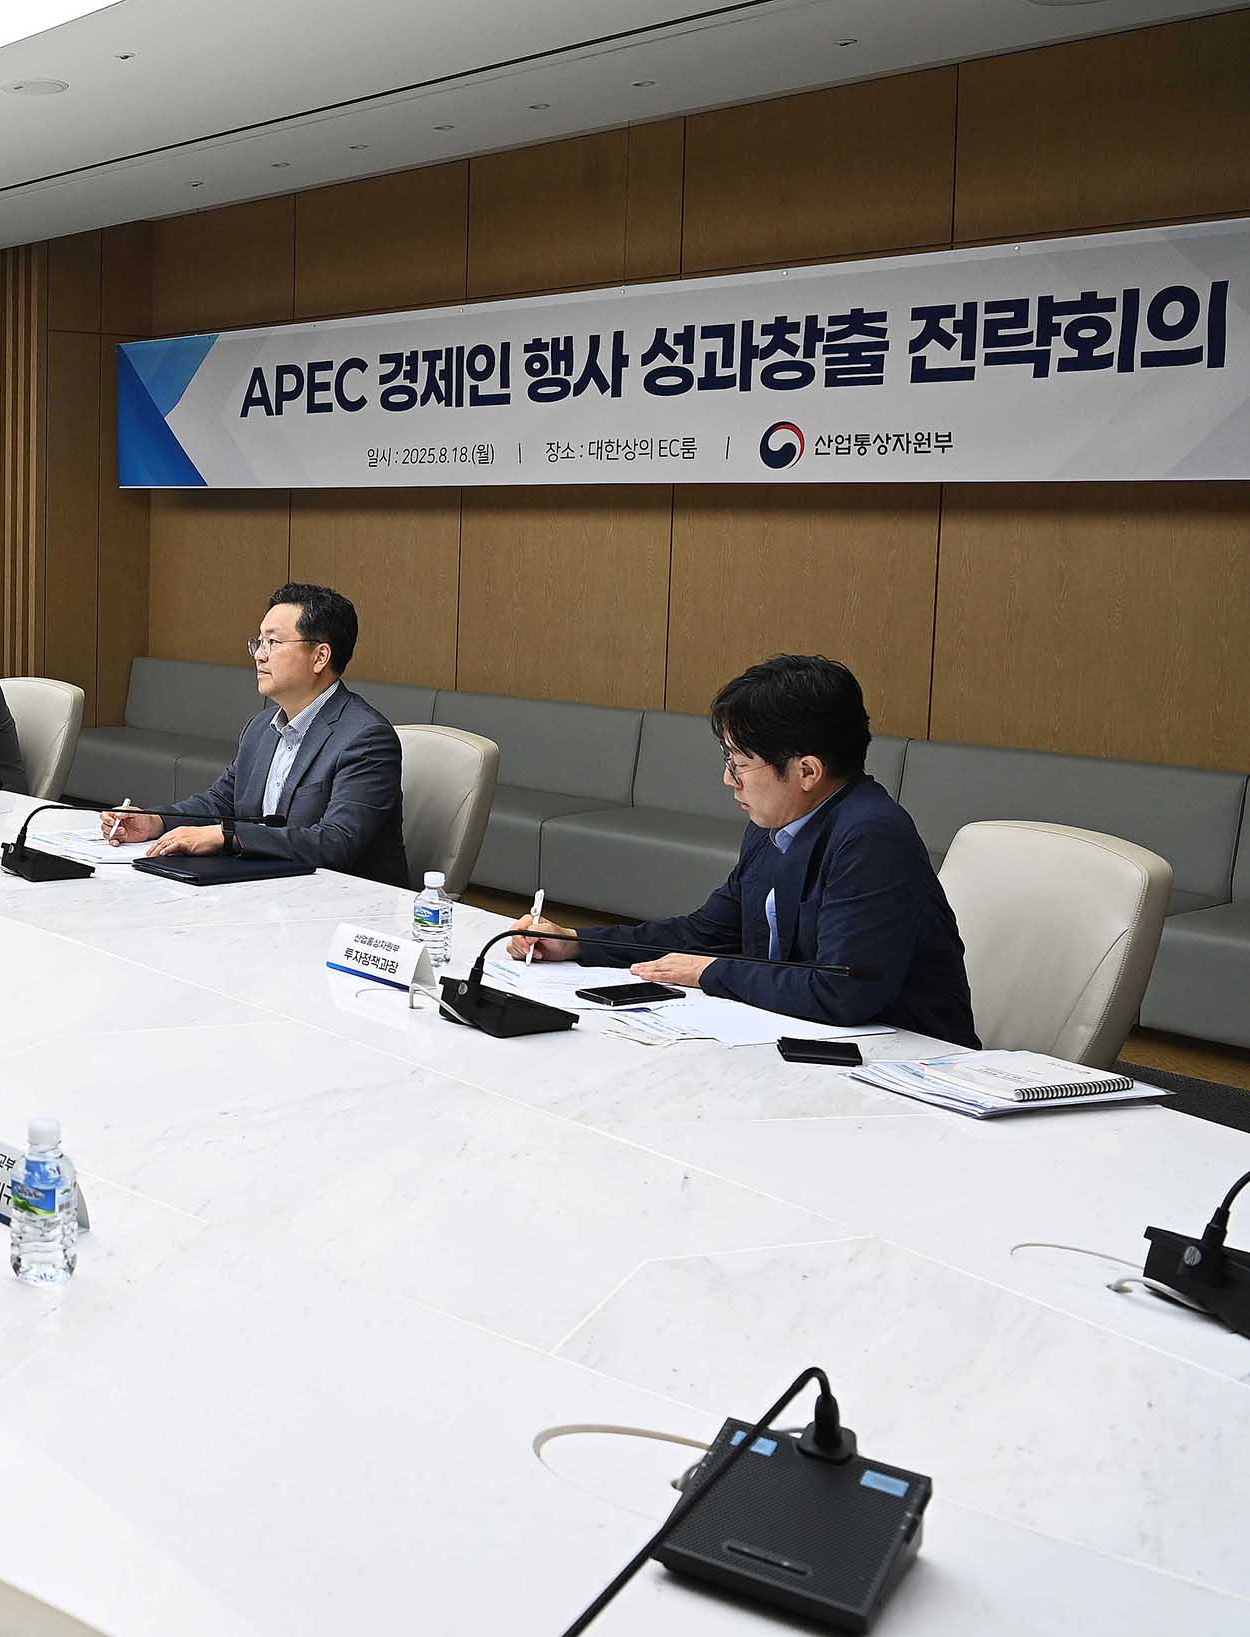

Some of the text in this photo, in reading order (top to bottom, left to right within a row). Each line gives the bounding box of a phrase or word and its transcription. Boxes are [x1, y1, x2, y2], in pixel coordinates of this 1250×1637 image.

[239, 280, 1231, 419] APEC 경제인 행사 성과창출 전략회의
[367, 447, 392, 468] 일시
[401, 443, 495, 465] 2025.8.18.(월)
[545, 440, 576, 464] 장소
[588, 438, 653, 461] 대한상의
[658, 437, 698, 460] EC룸
[814, 431, 954, 457] 산업통상자원부
[354, 933, 401, 954] 산업통상자원부
[344, 947, 399, 975] 투자정책과장
